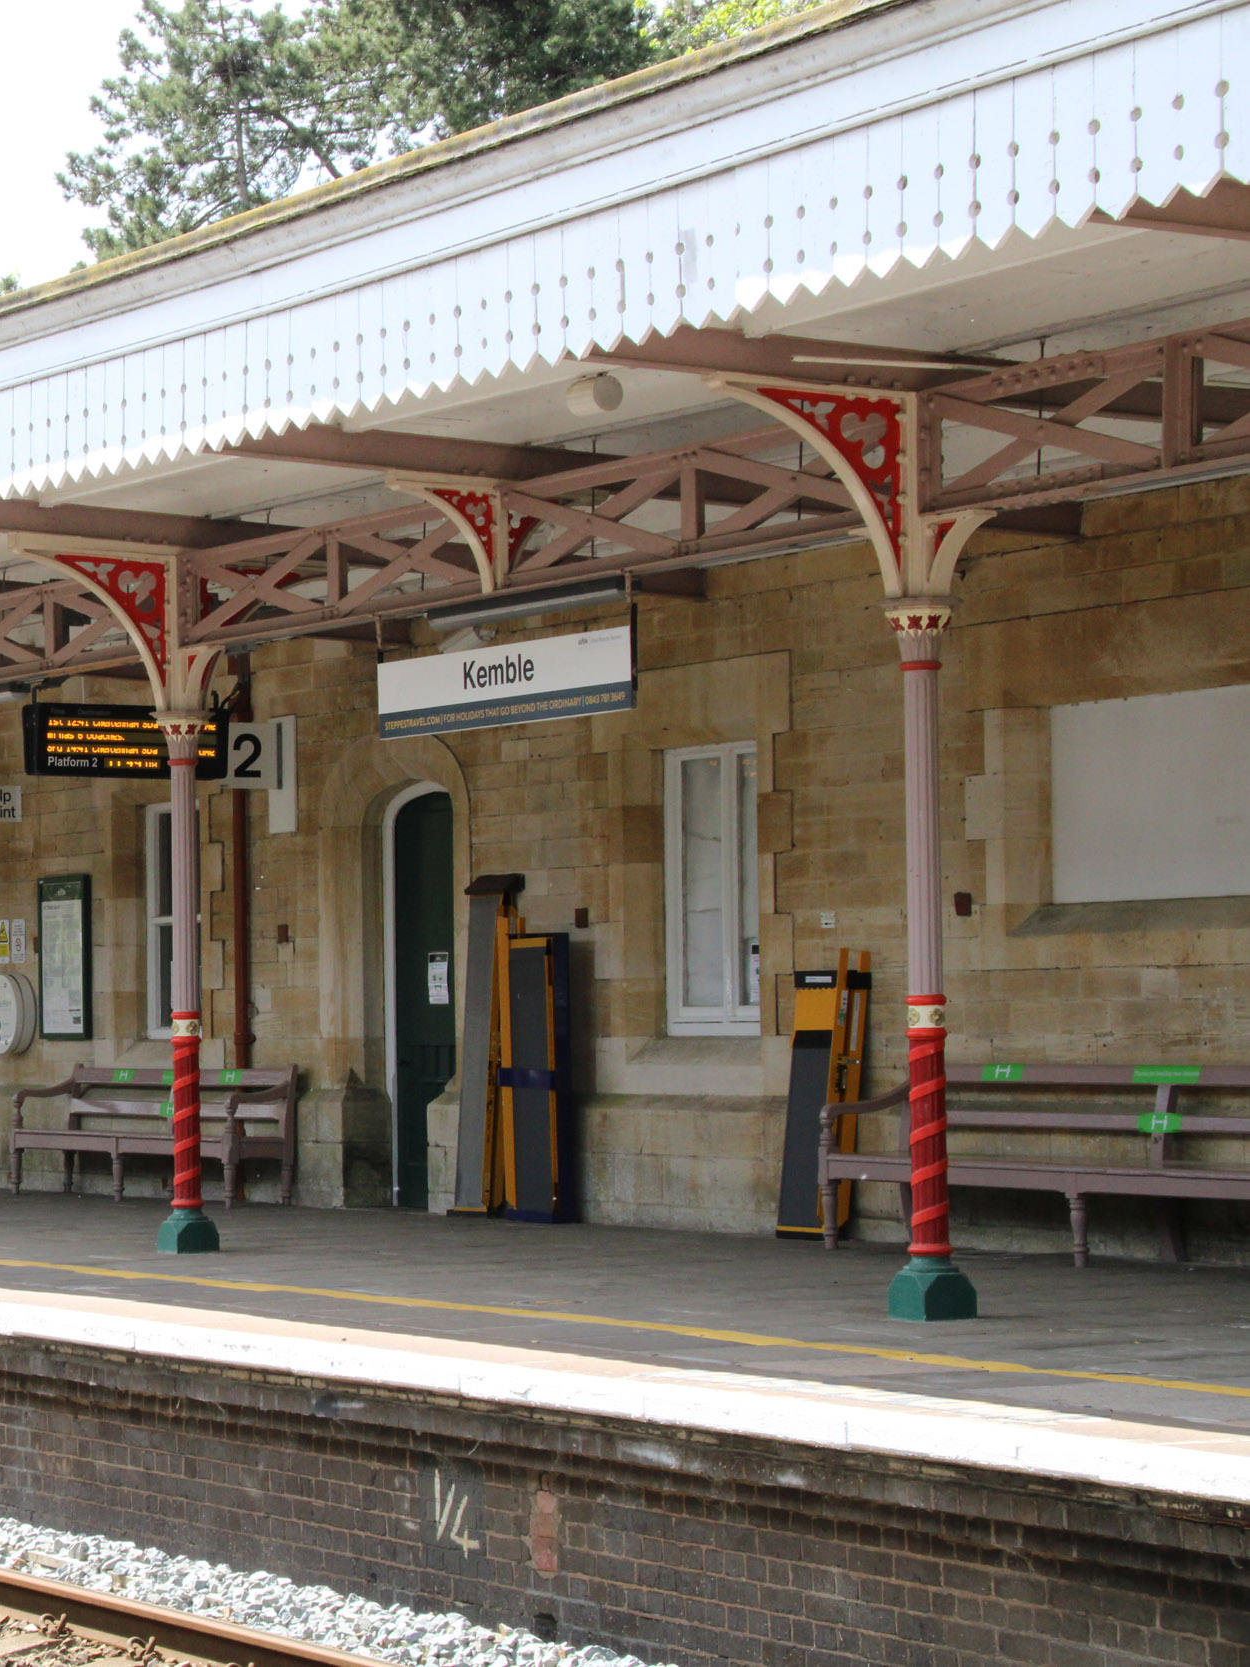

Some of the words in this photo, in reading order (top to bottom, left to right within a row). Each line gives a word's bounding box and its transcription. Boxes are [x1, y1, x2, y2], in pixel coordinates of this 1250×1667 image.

[463, 653, 535, 690] Kemble
[385, 716, 440, 730] STEPPESTRAVEL.COM
[444, 714, 455, 723] FOR
[456, 710, 485, 721] HOLIDAYS
[485, 708, 500, 717] THAT
[501, 706, 510, 715] GO
[511, 704, 536, 714] BEYOND
[537, 701, 548, 711] THE
[550, 697, 582, 709] ORDINARY
[585, 695, 600, 705] 0843
[601, 693, 610, 703] 781
[611, 691, 626, 702] 3649
[48, 756, 89, 768] Platform
[91, 757, 98, 767] 2
[233, 733, 261, 777] 2
